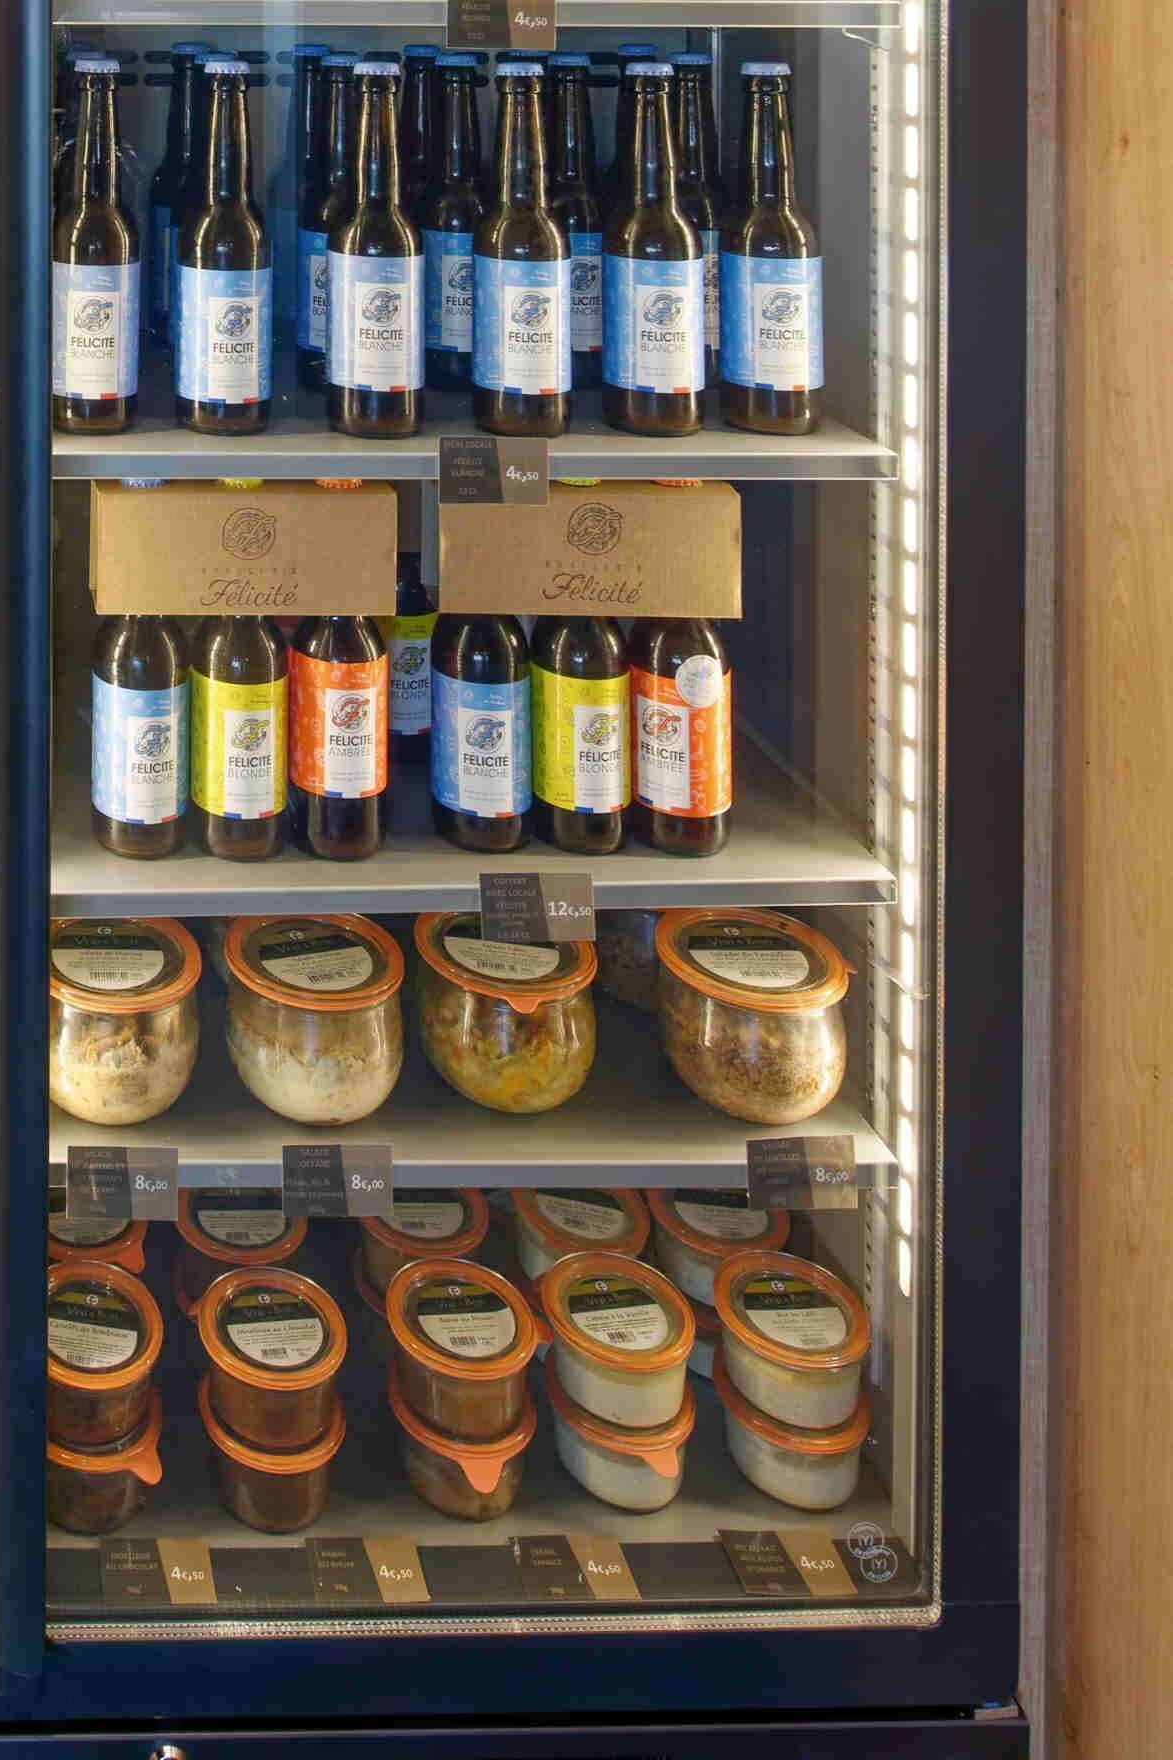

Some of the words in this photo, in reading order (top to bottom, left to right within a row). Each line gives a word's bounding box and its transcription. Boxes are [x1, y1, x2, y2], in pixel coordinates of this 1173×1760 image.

[505, 465, 539, 483] 4€,50
[547, 900, 593, 919] 12€,50
[135, 1174, 169, 1193] 8€,00
[351, 1174, 385, 1193] 8€,00
[815, 1167, 850, 1184] 8€,00
[170, 1565, 205, 1584] 4€,50
